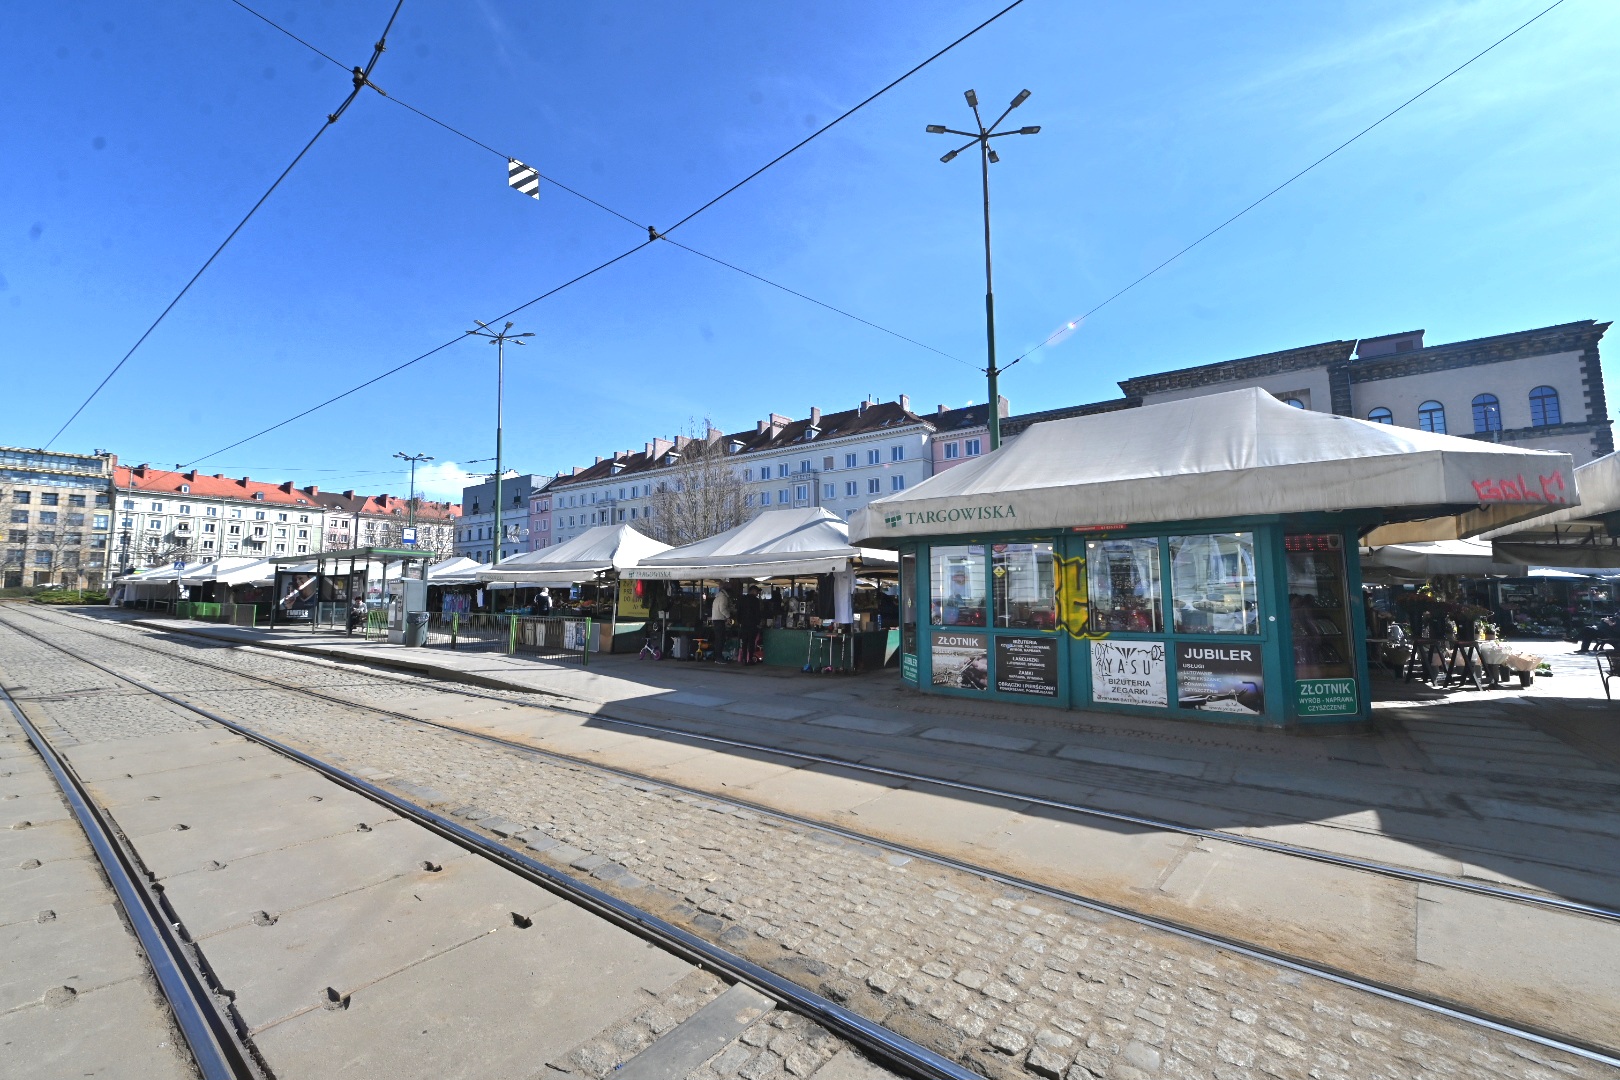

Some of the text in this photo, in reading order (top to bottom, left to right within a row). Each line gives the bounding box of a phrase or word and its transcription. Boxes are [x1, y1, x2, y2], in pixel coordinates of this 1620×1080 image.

[905, 505, 1016, 524] TARGOWISKA
[938, 636, 979, 647] ZŁOTNIK
[1184, 648, 1252, 661] JUBILER
[1106, 658, 1151, 675] YASU
[1108, 678, 1151, 687] BIŻUTERIA
[1111, 686, 1148, 695] ZEGARKI
[1300, 683, 1351, 695] ZŁOTNIK
